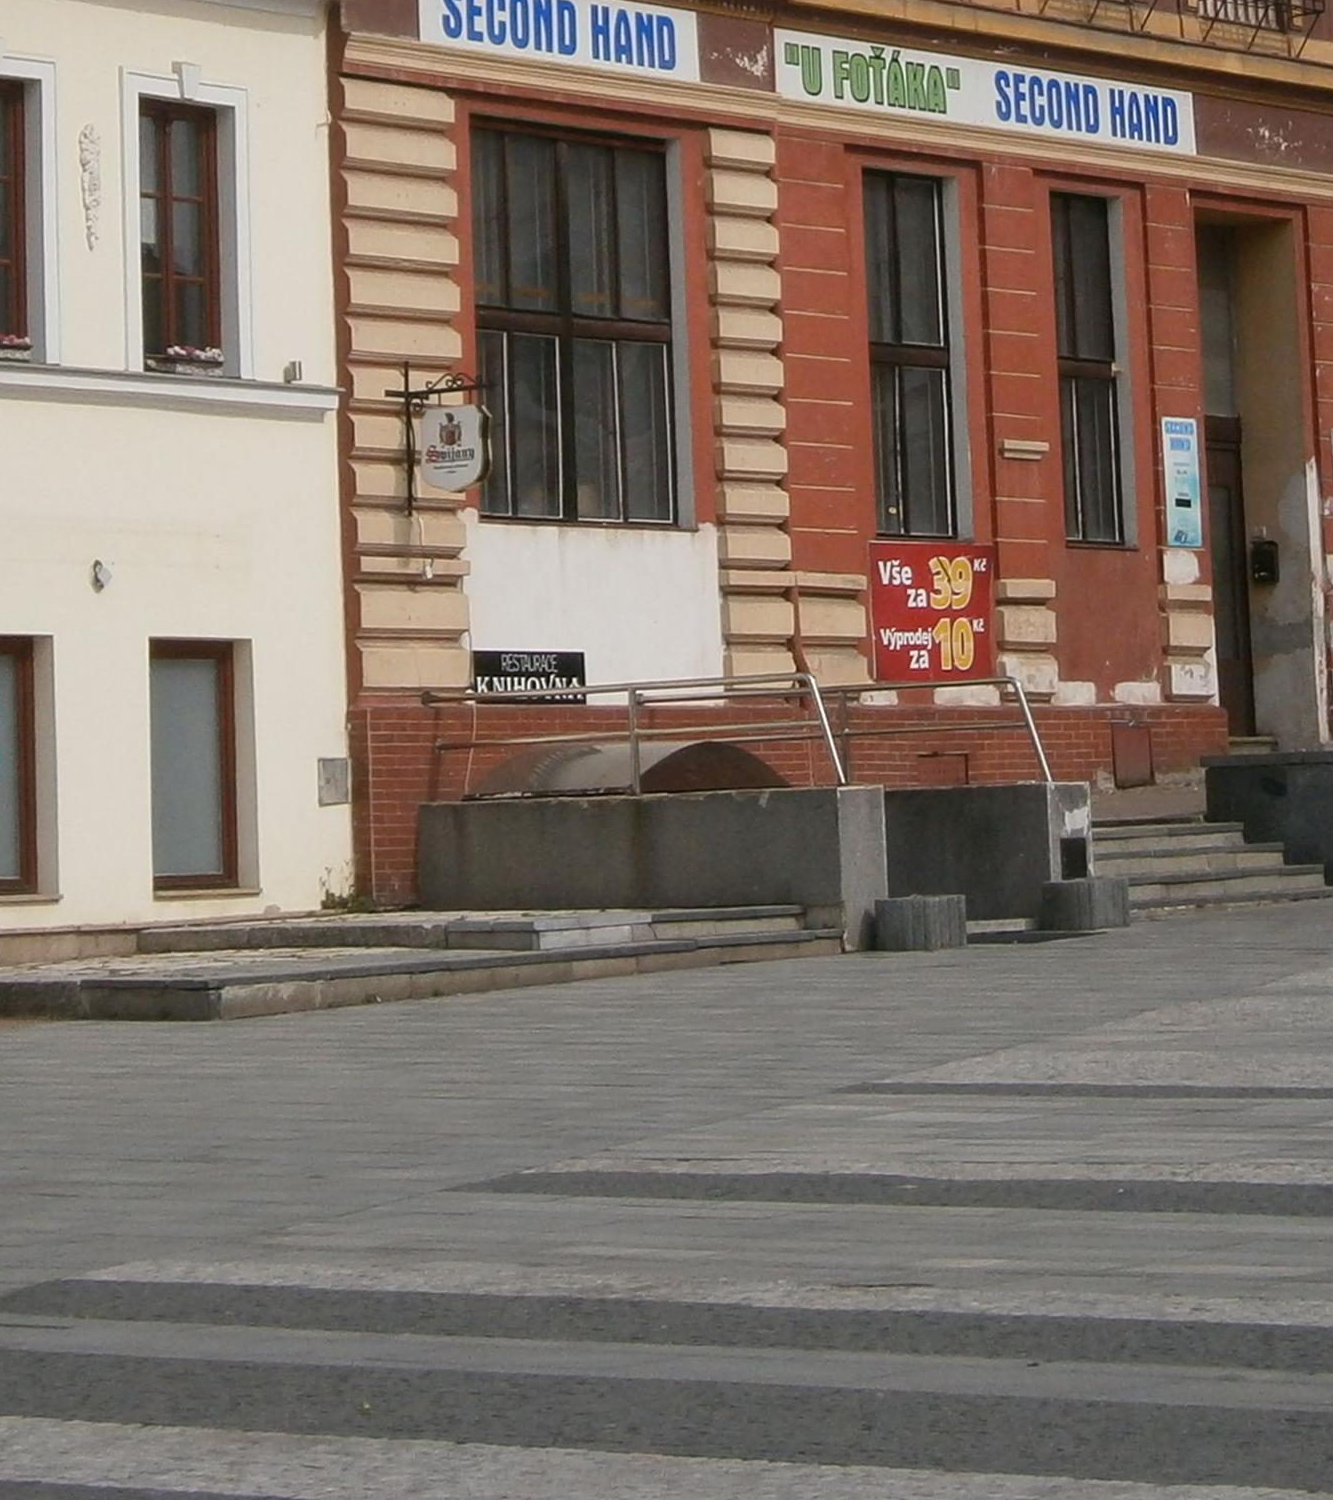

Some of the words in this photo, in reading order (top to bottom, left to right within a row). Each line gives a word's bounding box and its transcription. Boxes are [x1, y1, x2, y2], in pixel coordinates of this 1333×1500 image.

[589, 3, 677, 71] HAND
[994, 69, 1101, 135] SECOND
[1108, 87, 1180, 146] HAND
[877, 559, 913, 586] Vše
[906, 588, 927, 608] za
[928, 556, 973, 610] 39
[973, 558, 987, 572] Kč
[501, 653, 558, 673] RESTAURACE
[880, 627, 933, 650] Výprodej
[909, 649, 930, 669] za
[932, 617, 975, 671] 10
[971, 618, 985, 632] Kč
